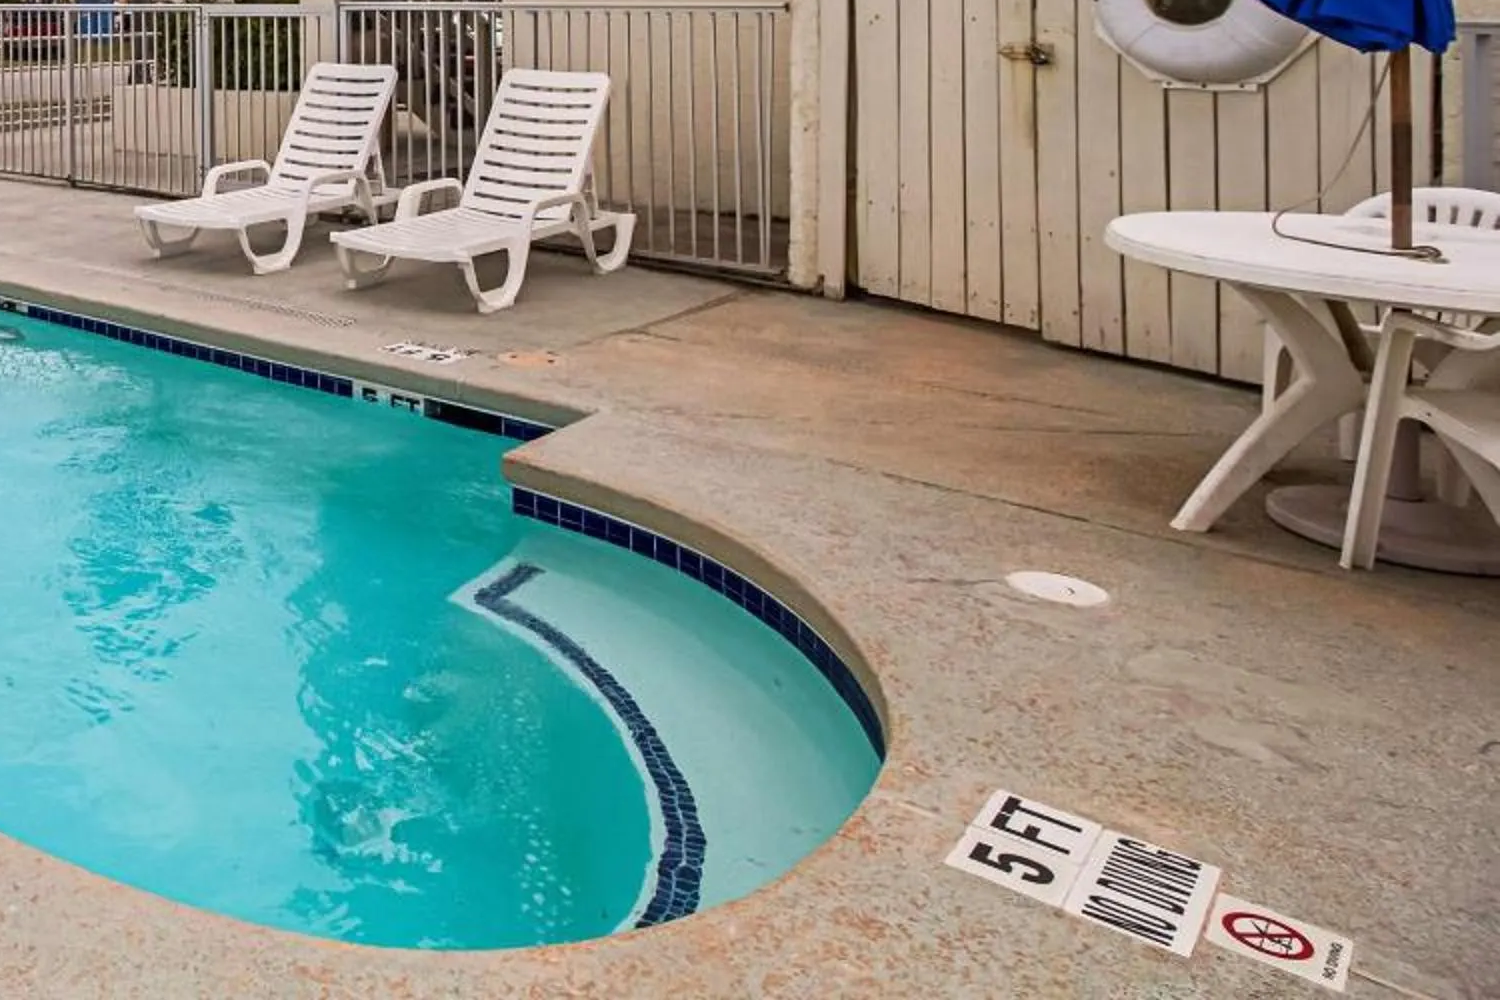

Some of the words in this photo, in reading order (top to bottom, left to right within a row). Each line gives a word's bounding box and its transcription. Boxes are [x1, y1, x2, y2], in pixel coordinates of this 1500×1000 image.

[990, 796, 1083, 855] FT
[968, 841, 1055, 885] 5
[1096, 837, 1202, 915] DIVING
[1081, 895, 1178, 946] NO
